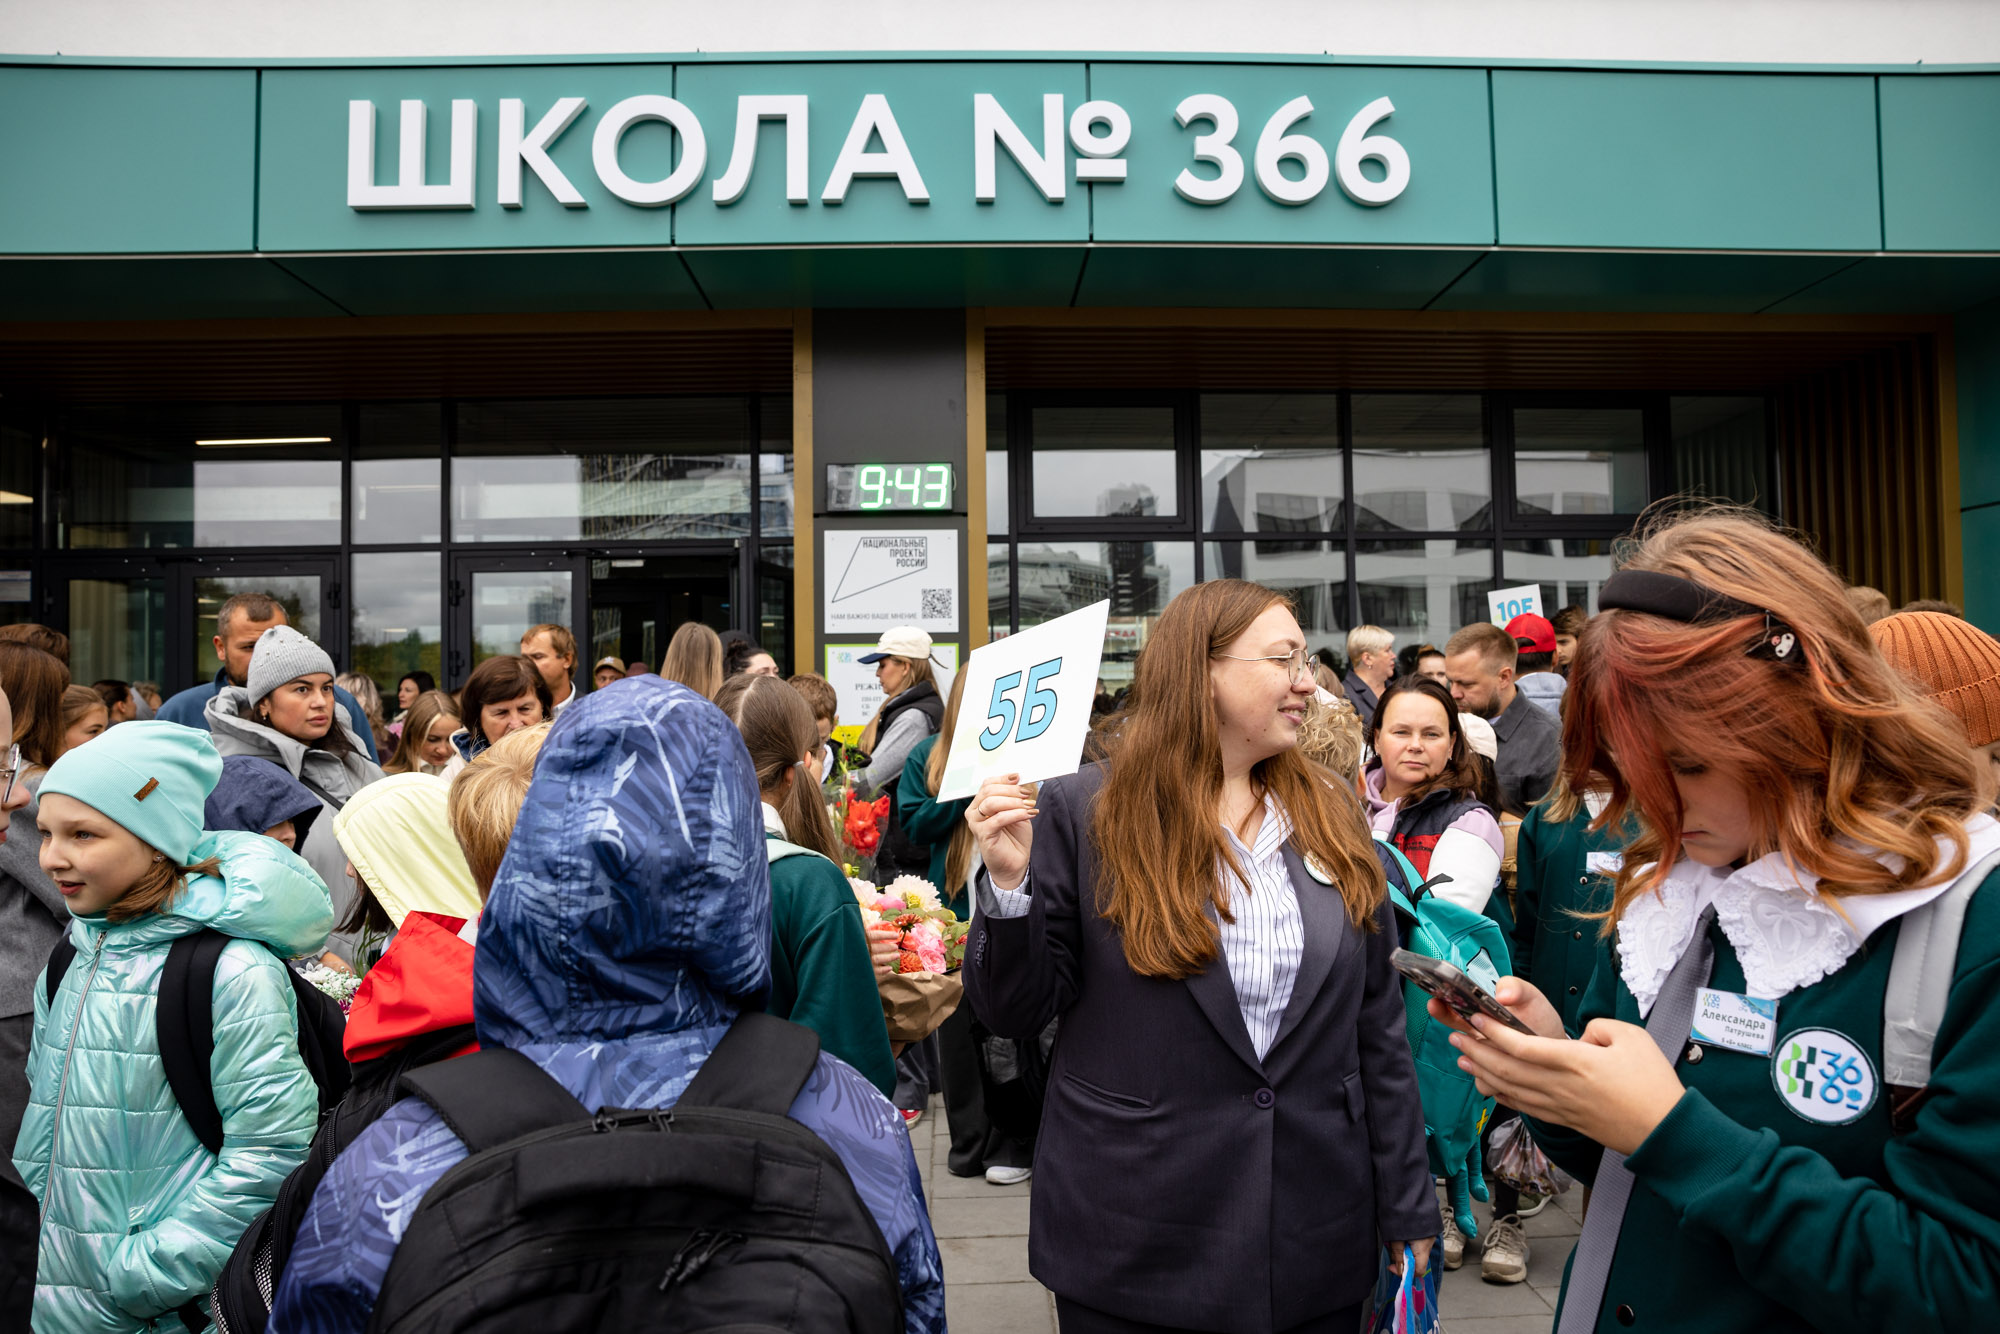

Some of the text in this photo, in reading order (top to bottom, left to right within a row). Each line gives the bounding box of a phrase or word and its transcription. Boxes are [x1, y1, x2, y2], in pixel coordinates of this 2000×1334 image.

[347, 92, 1412, 212] ШКОЛА № 366
[859, 464, 950, 510] 9:43
[862, 539, 925, 549] НАЦИОНАЛЬНЫЕ
[889, 549, 925, 558] ПРОЕКТЫ
[896, 558, 925, 567] РОССИИ
[855, 683, 882, 691] РЕЖИ
[978, 656, 1063, 752] 5Б
[1701, 1008, 1766, 1031] Александра
[1725, 1026, 1765, 1040] Патрушева
[1737, 1041, 1753, 1050] класс
